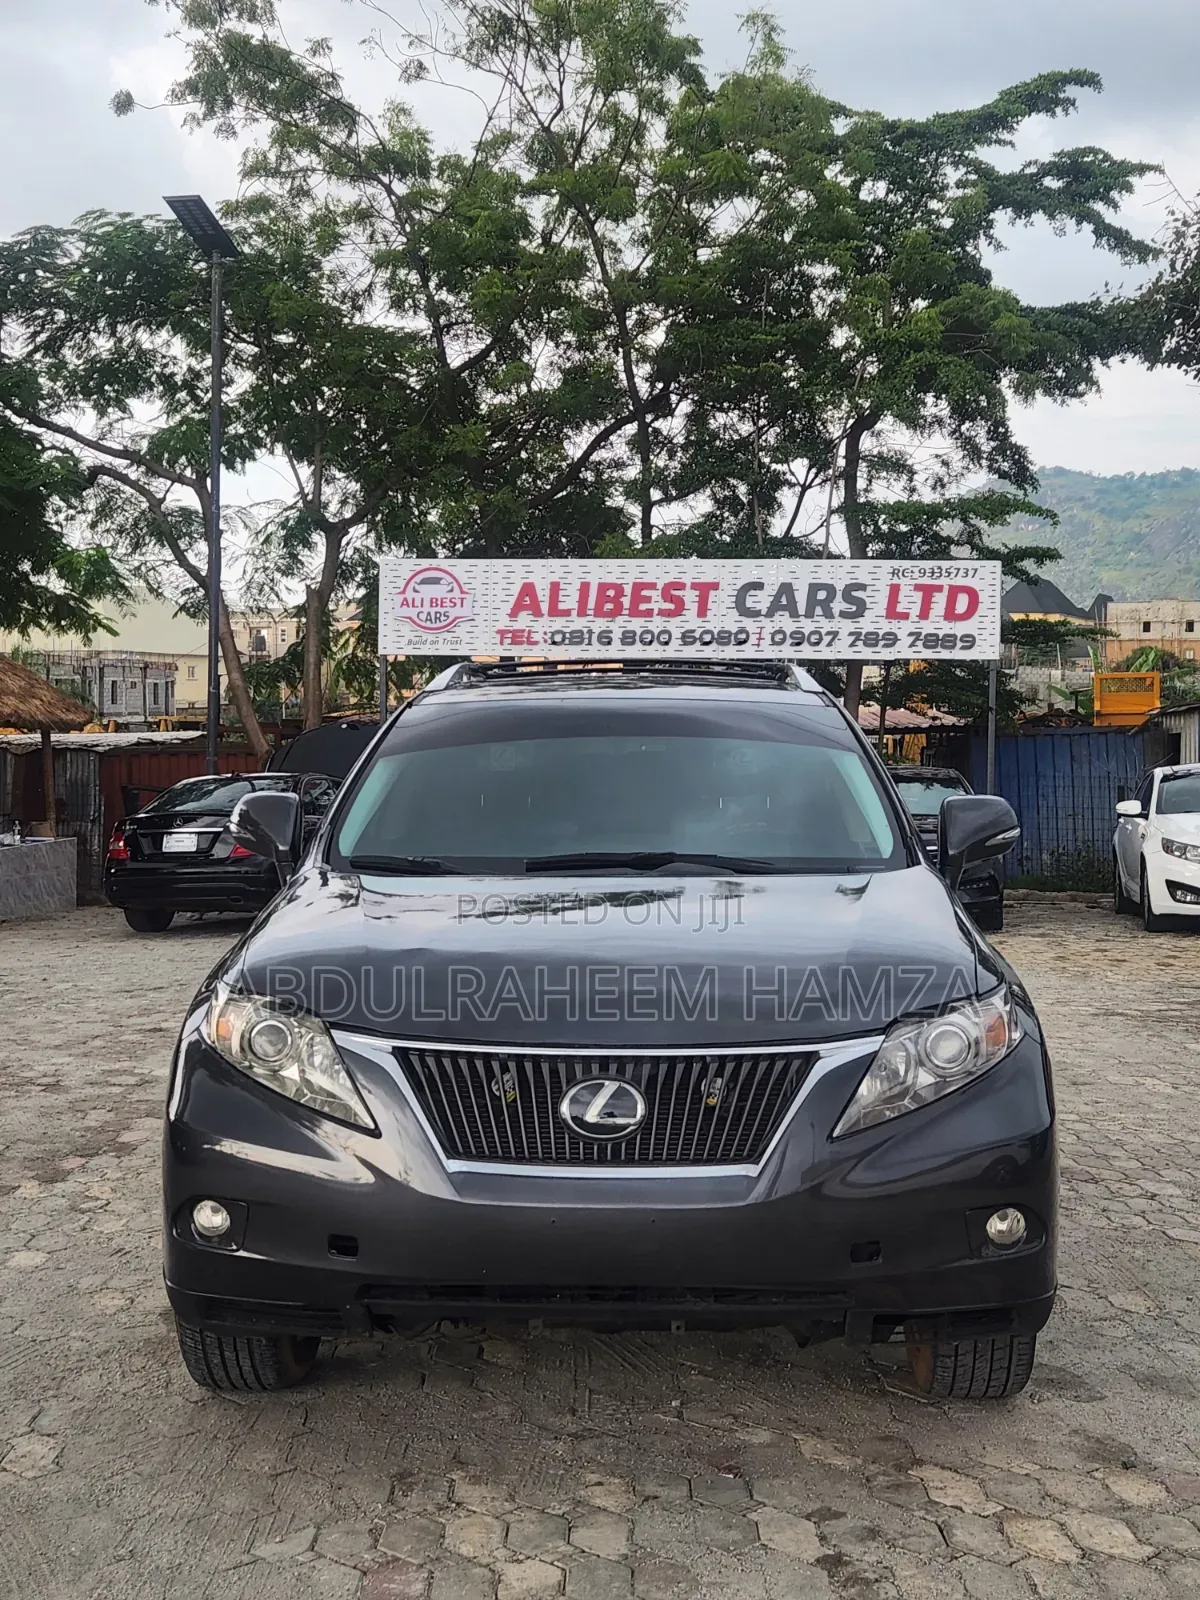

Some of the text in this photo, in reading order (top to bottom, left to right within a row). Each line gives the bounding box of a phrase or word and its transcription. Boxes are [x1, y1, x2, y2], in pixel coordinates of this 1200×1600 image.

[891, 567, 978, 580] RC: 9335737
[400, 597, 467, 608] ALI BEST
[508, 580, 980, 622] ALIBEST CARS LTD
[416, 611, 450, 624] CARS
[407, 638, 428, 646] Build
[442, 638, 463, 646] Trust
[620, 629, 673, 646] 800
[770, 629, 840, 647] 0907
[847, 631, 899, 648] 789
[907, 631, 977, 650] 7889
